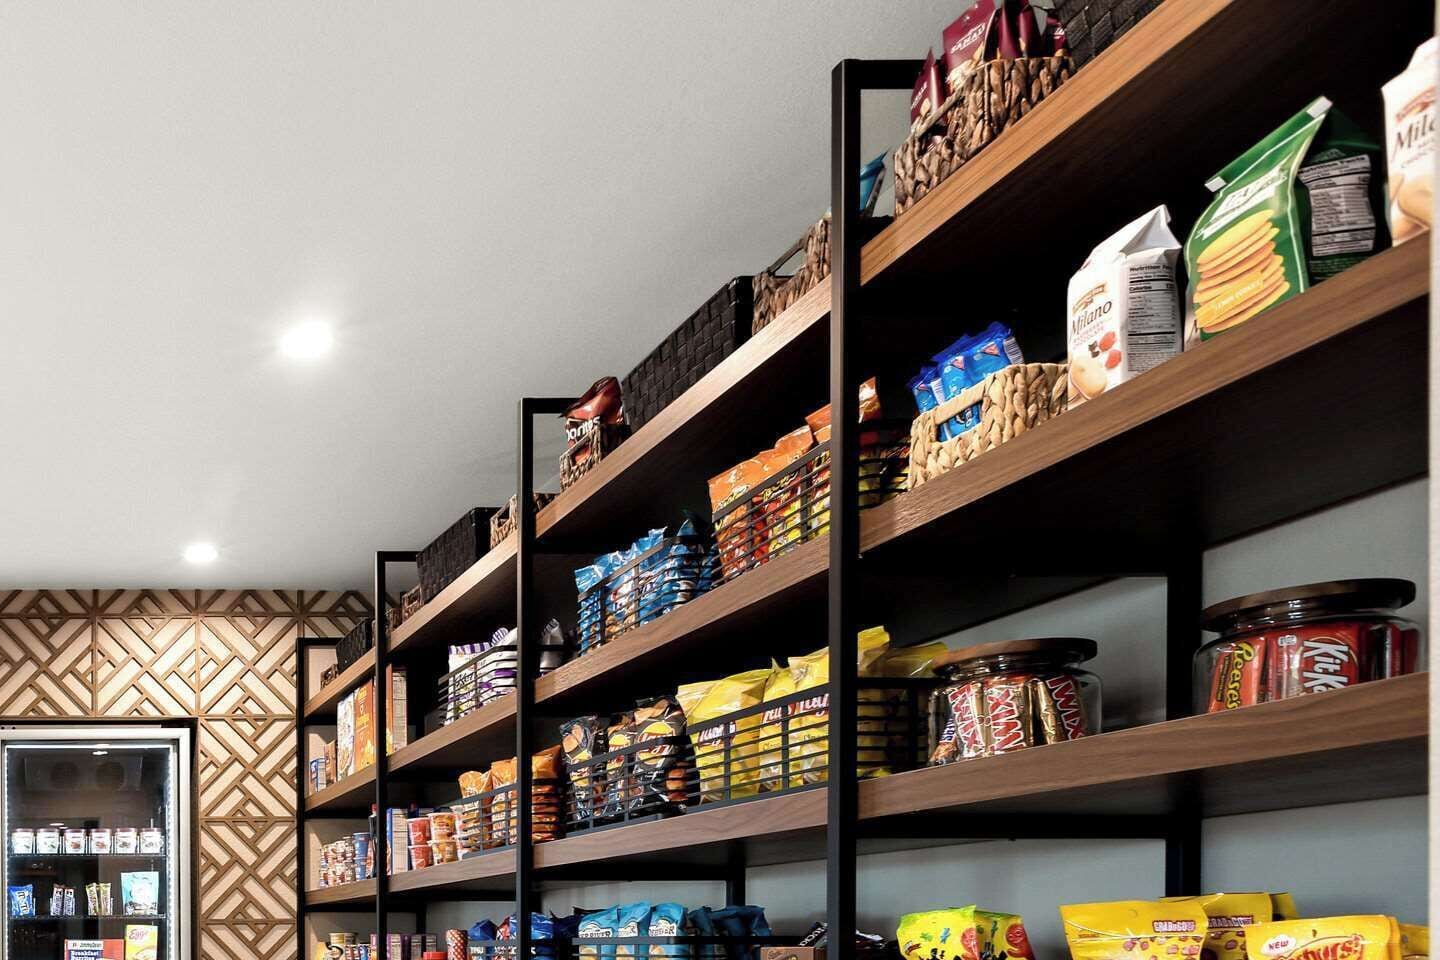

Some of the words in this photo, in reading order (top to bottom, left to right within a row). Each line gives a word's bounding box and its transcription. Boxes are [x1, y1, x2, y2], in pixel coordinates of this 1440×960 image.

[1072, 300, 1113, 337] Milano
[1225, 641, 1255, 709] Reese's
[1269, 940, 1289, 951] NEW
